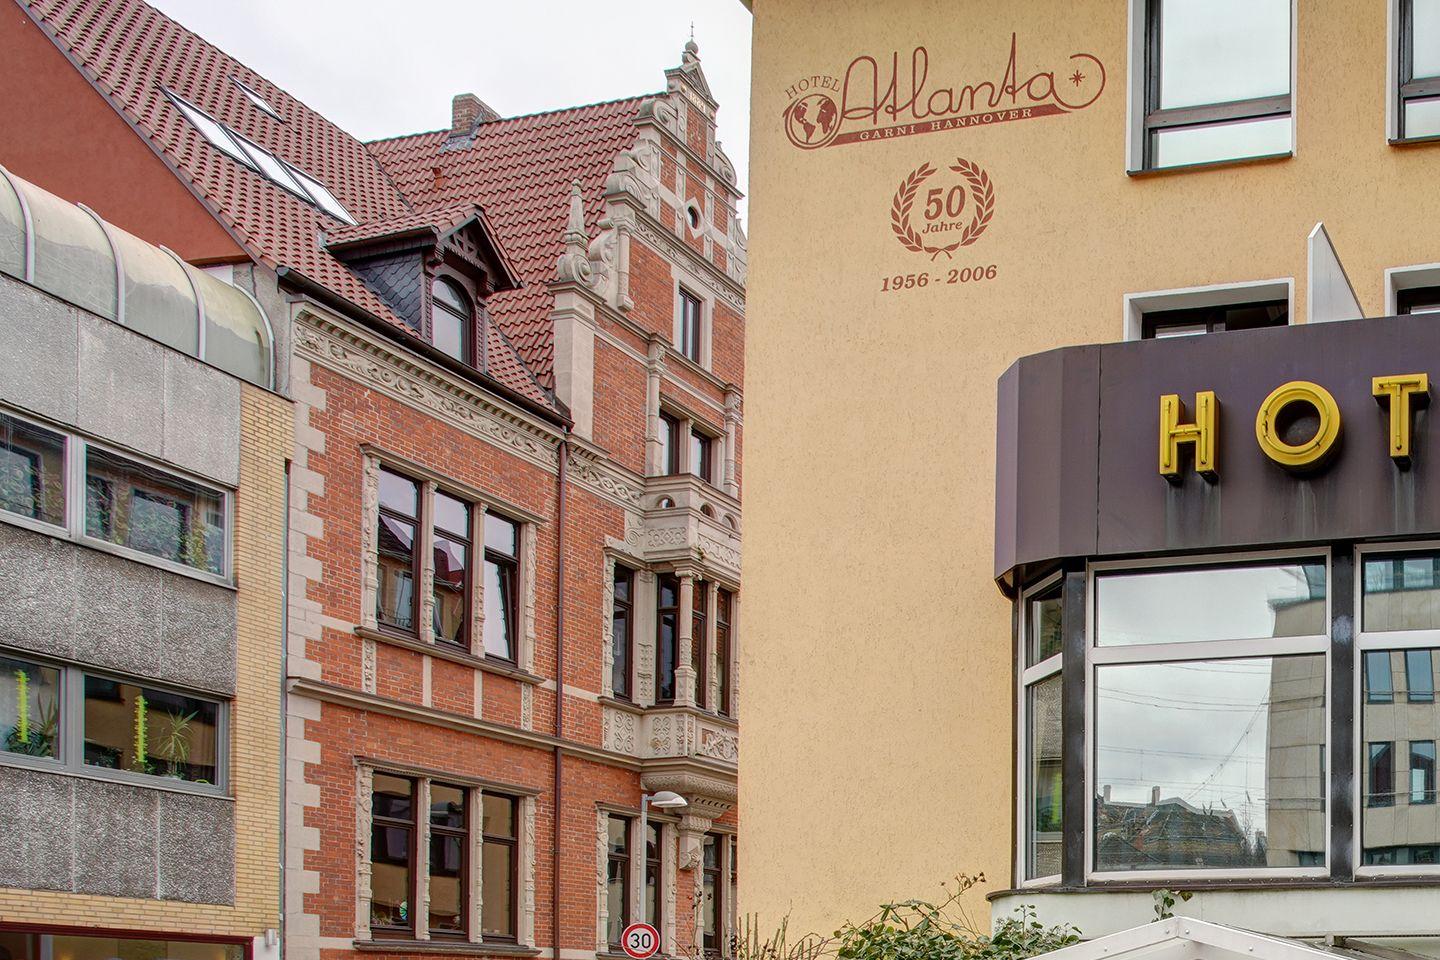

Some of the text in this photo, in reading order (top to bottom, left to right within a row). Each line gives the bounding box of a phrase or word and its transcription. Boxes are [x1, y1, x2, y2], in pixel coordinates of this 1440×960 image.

[784, 75, 841, 100] HOTEL
[842, 32, 1106, 125] Atlanta
[859, 108, 1033, 141] GARNI HANNOVER
[923, 185, 966, 220] 50
[921, 218, 963, 235] Jahre
[880, 272, 929, 292] 1956
[947, 264, 998, 284] 2006
[630, 933, 651, 948] 30
